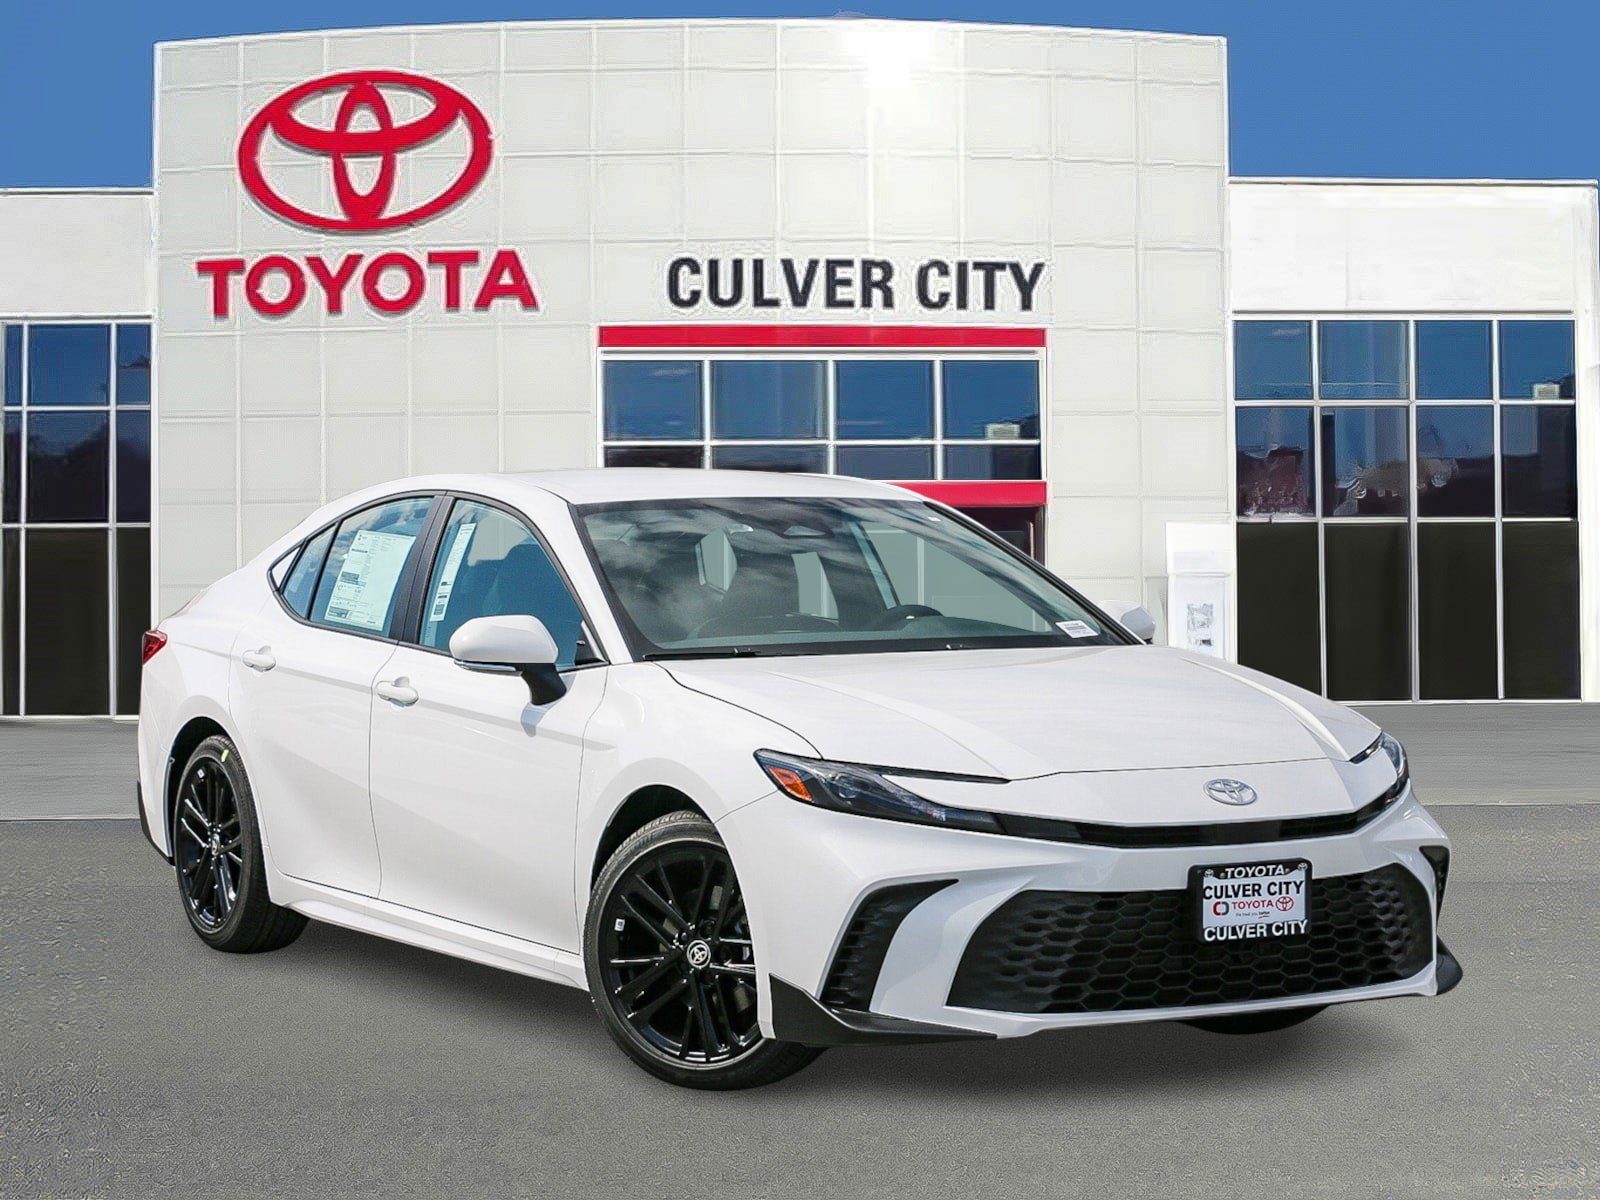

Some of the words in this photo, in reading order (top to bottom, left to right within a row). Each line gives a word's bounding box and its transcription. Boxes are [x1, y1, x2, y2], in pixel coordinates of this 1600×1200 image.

[197, 249, 539, 319] TOYOTA
[667, 257, 895, 310] CULVER
[916, 259, 1045, 312] CITY
[1225, 865, 1285, 878] TOYOTA
[1204, 883, 1262, 899] CULVER
[1267, 881, 1304, 896] CITY
[1232, 899, 1274, 909] TOYOTA
[1204, 923, 1267, 940] CULVER
[1272, 920, 1308, 936] CITY
